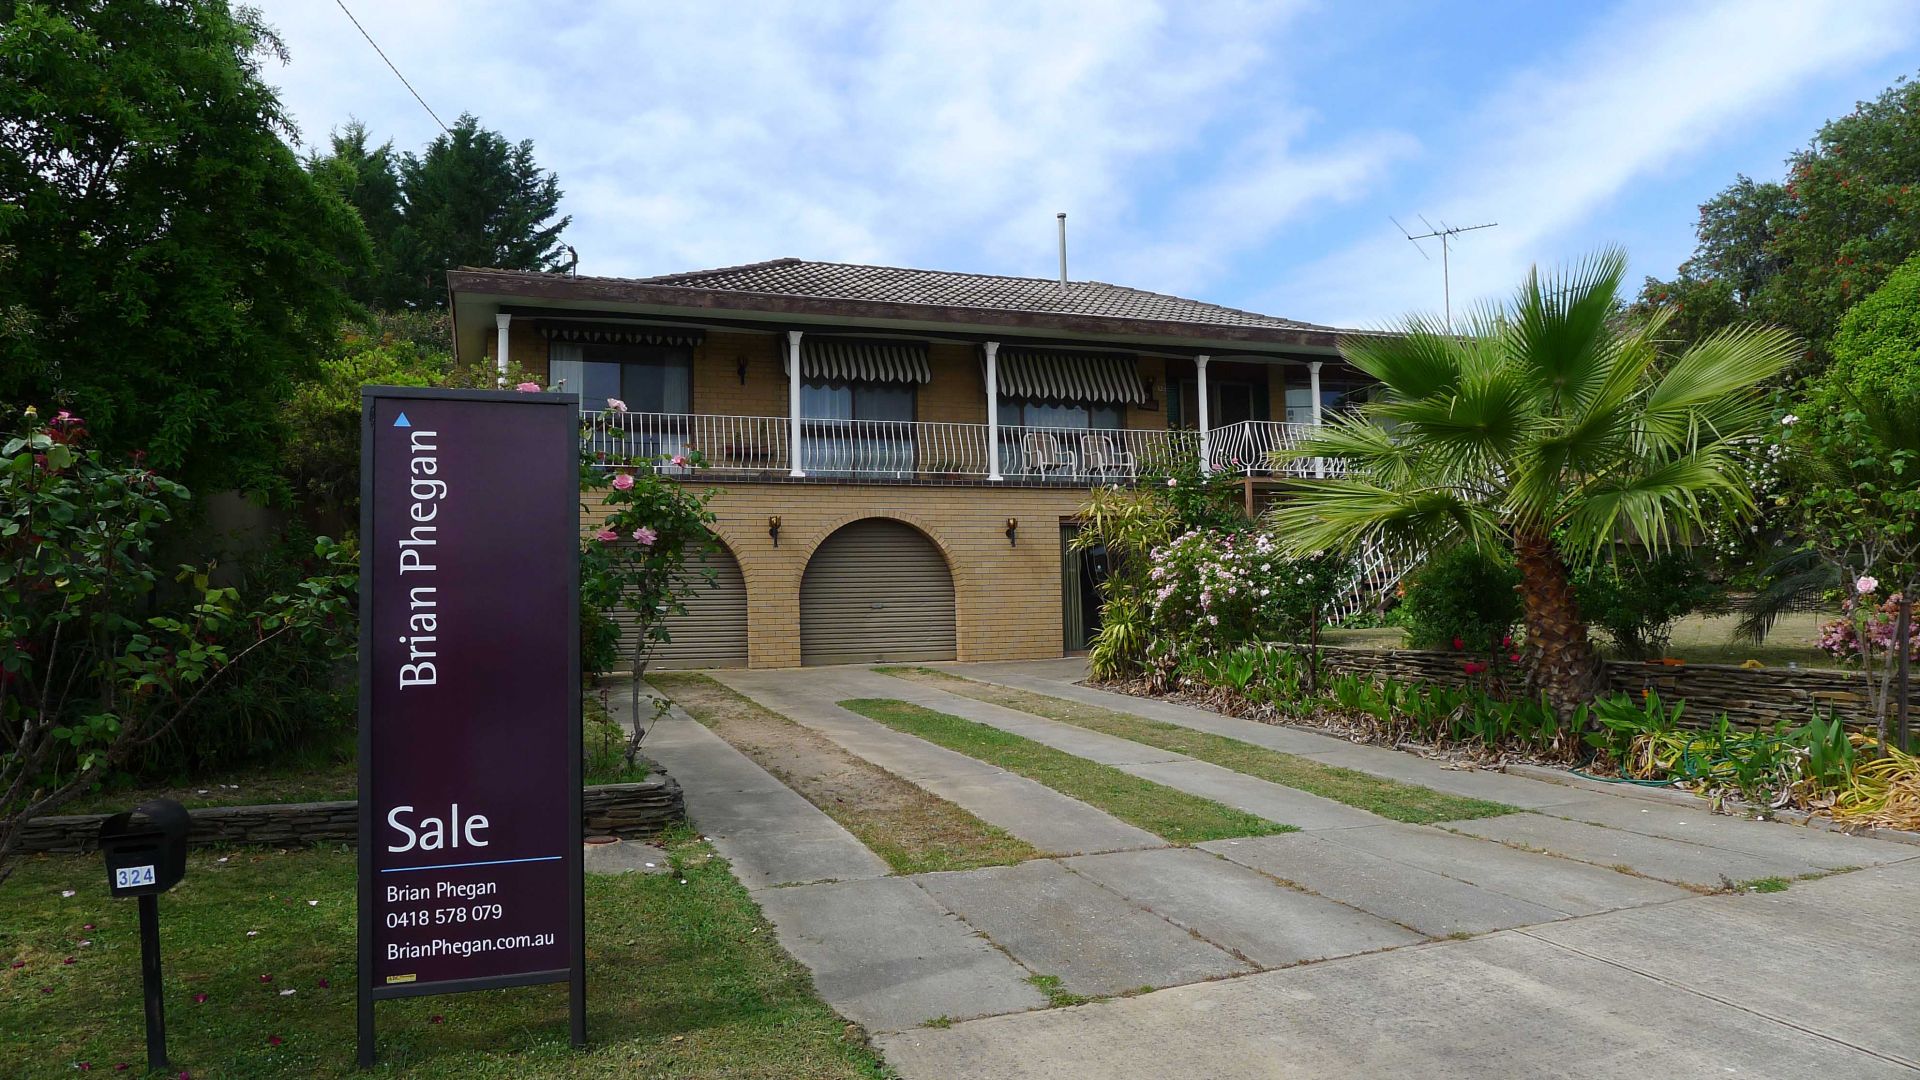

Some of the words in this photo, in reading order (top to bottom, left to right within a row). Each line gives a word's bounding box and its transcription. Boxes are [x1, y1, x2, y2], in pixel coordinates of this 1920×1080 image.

[398, 430, 448, 576] Phegan
[398, 587, 437, 691] Brian
[387, 803, 490, 853] Sale
[119, 868, 153, 886] 324
[387, 884, 430, 902] Brian
[436, 881, 497, 899] Phegan
[386, 910, 430, 929] 0418
[435, 906, 467, 925] 578
[471, 903, 503, 921] 079
[387, 932, 555, 960] BrianPhegan.com.au
